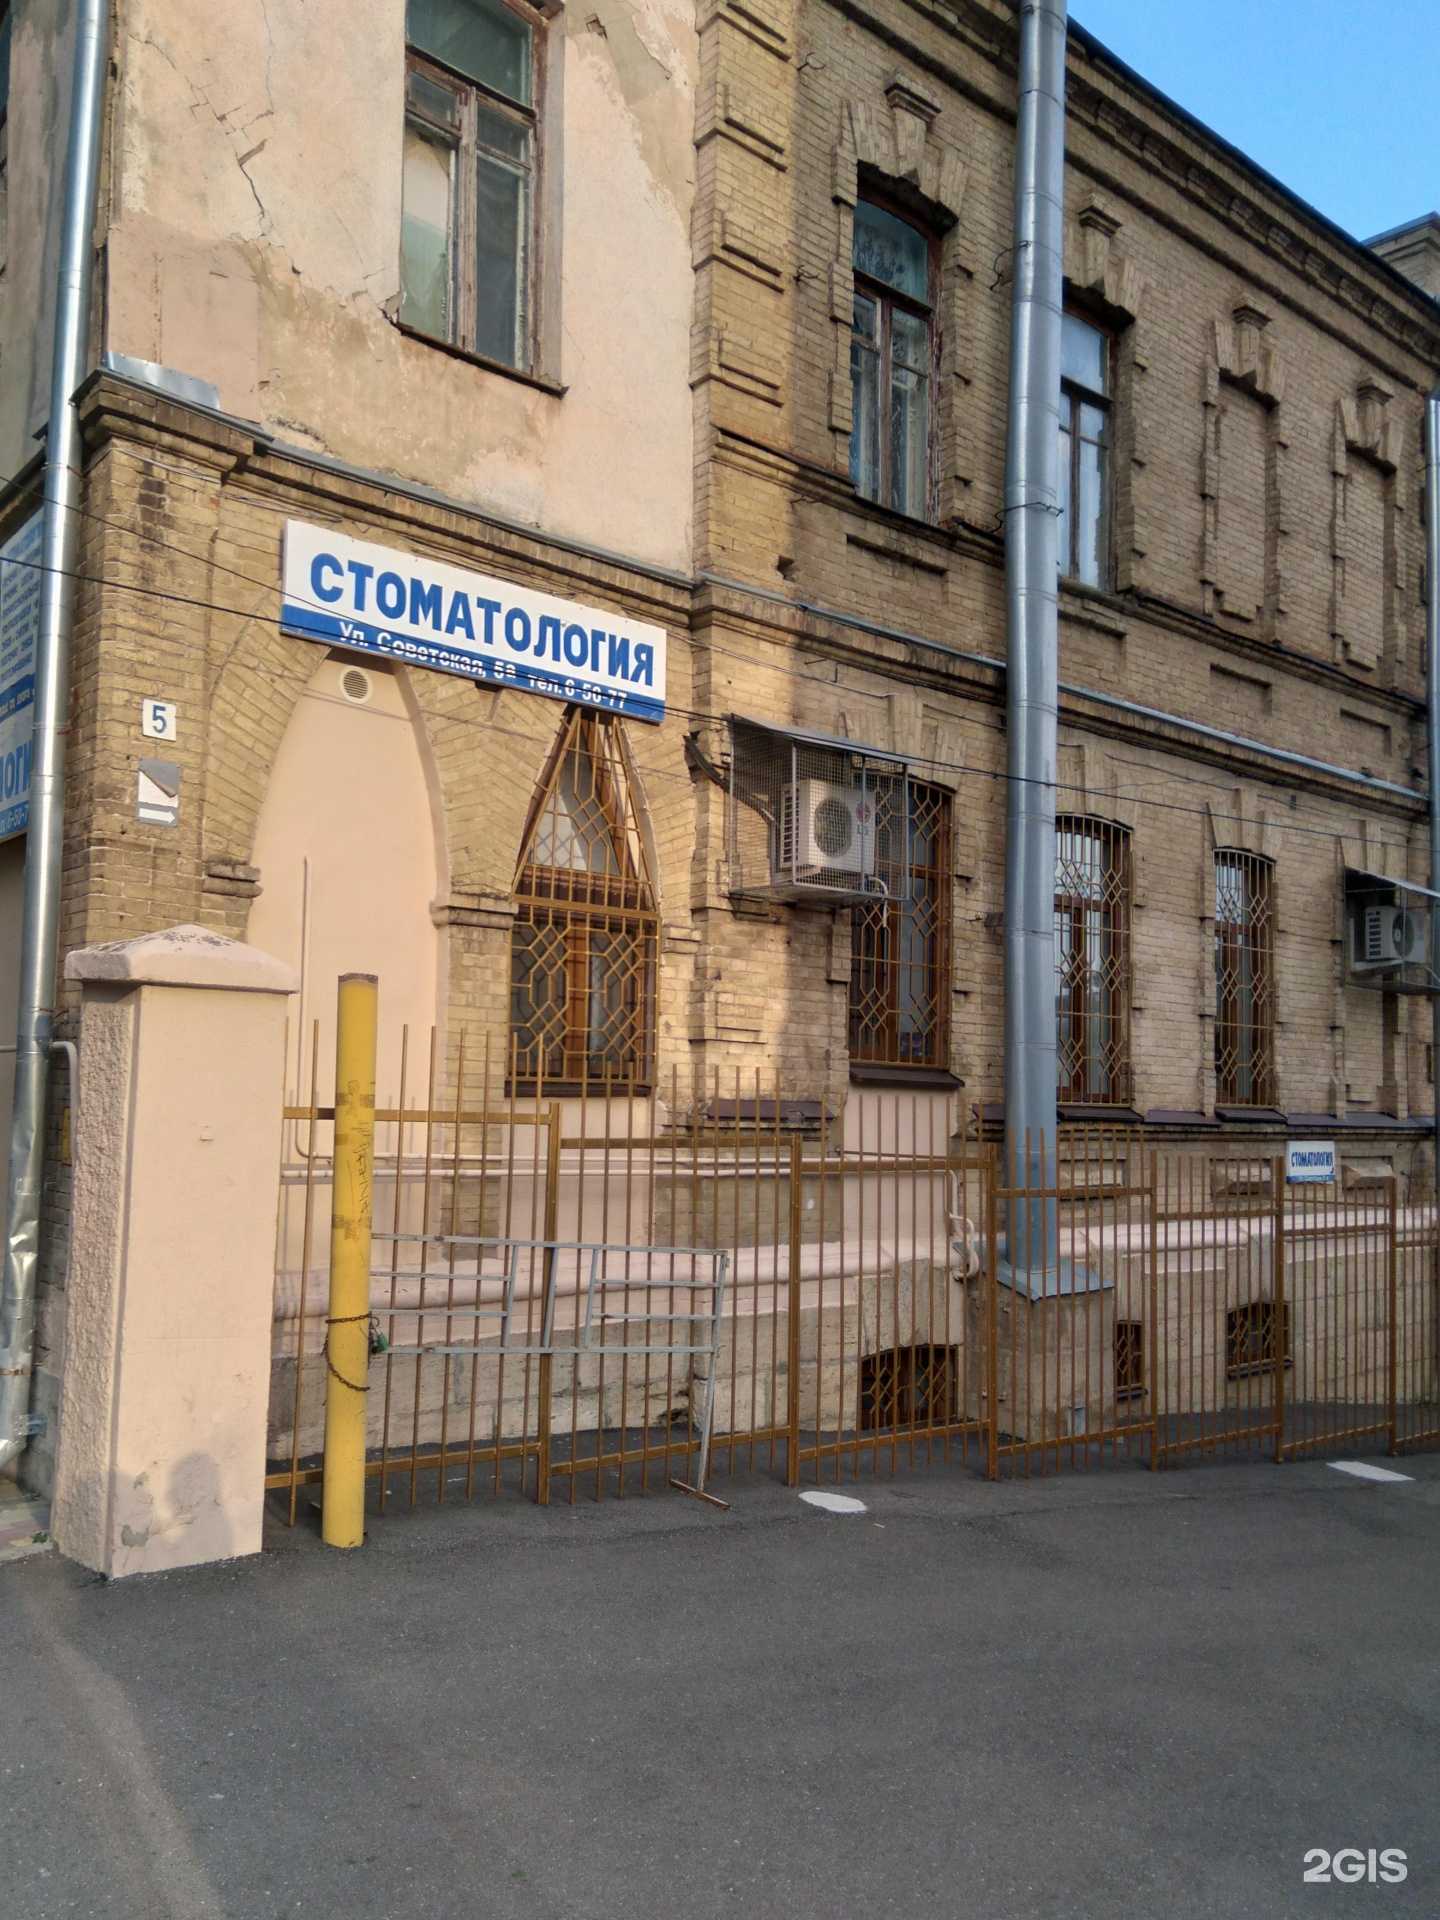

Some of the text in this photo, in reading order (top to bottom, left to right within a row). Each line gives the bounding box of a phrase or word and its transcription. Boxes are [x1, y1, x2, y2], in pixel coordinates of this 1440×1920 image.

[310, 552, 654, 687] СТОМАТОЛОГИЯ
[338, 621, 369, 646] Ул.
[377, 632, 487, 678] Советская,
[151, 704, 168, 734] 5
